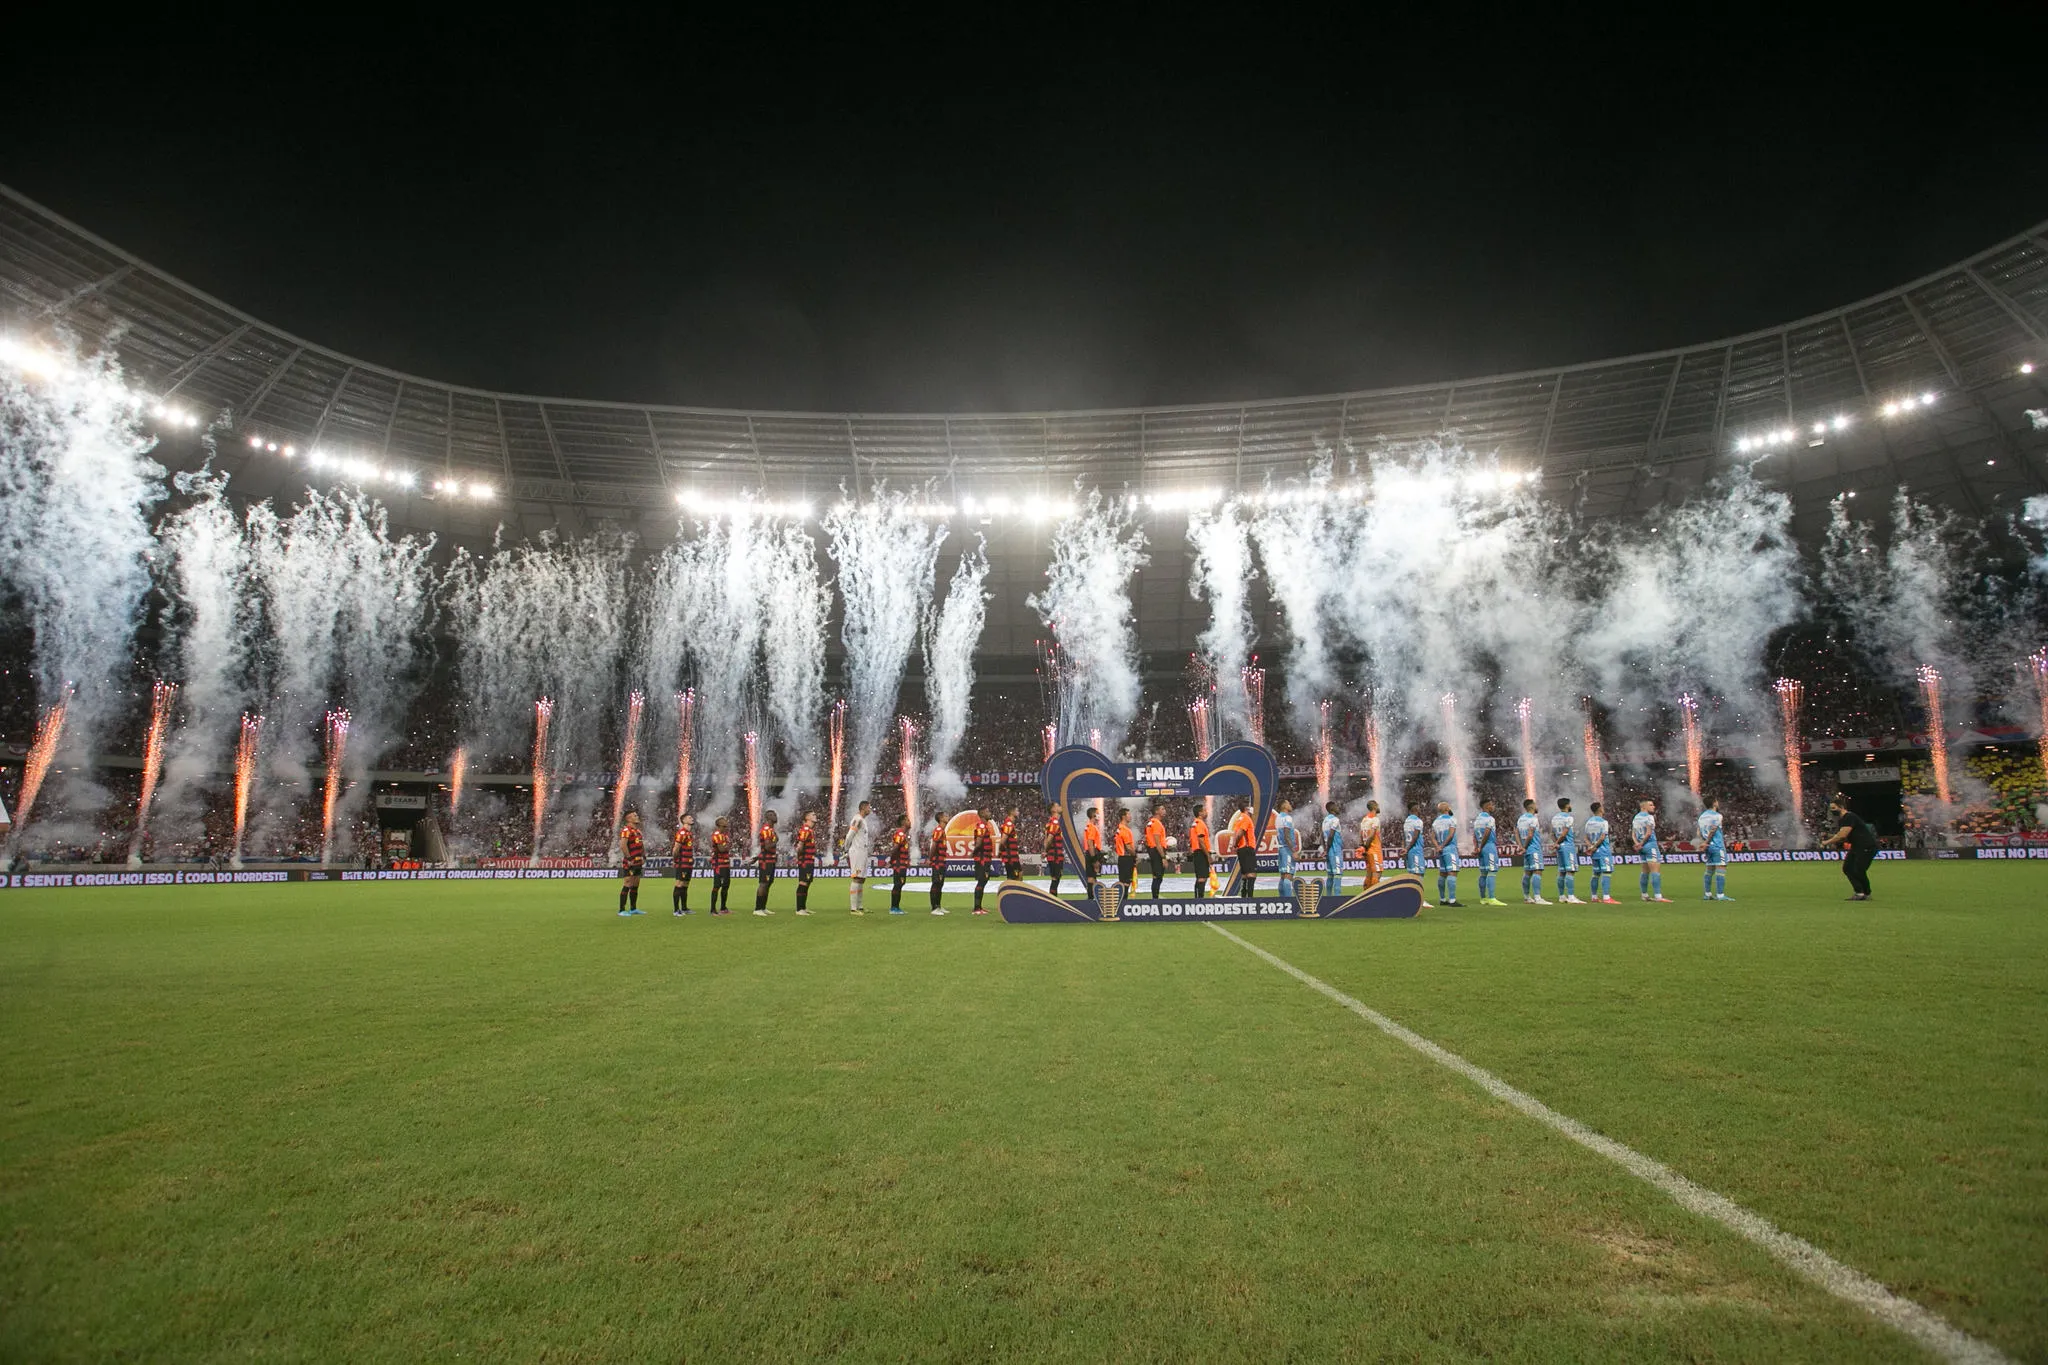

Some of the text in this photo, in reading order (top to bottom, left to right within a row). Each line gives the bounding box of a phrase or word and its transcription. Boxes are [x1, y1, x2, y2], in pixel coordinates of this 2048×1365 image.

[1136, 764, 1184, 781] FINAL
[1665, 853, 1699, 863] SENTE
[1756, 852, 1782, 861] ISSO
[1783, 849, 1791, 861] É
[1792, 851, 1822, 860] COPA
[1822, 851, 1840, 860] DO
[1977, 848, 2006, 858] BATE
[2007, 848, 2026, 858] NO
[11, 875, 21, 887] E
[24, 874, 73, 887] SENTE
[75, 873, 143, 886] ORGULHO!
[145, 873, 174, 884] ISSO
[176, 870, 183, 883] É
[185, 872, 215, 883] COPA
[217, 872, 232, 883] DO
[234, 871, 288, 882] NORDESTE!
[342, 867, 619, 880] BATE NO PEITO E SENTE ORGULHO! ISSO É COPA DO NORDESTE!
[1124, 902, 1292, 917] COPA DO NORDESTE 2022
